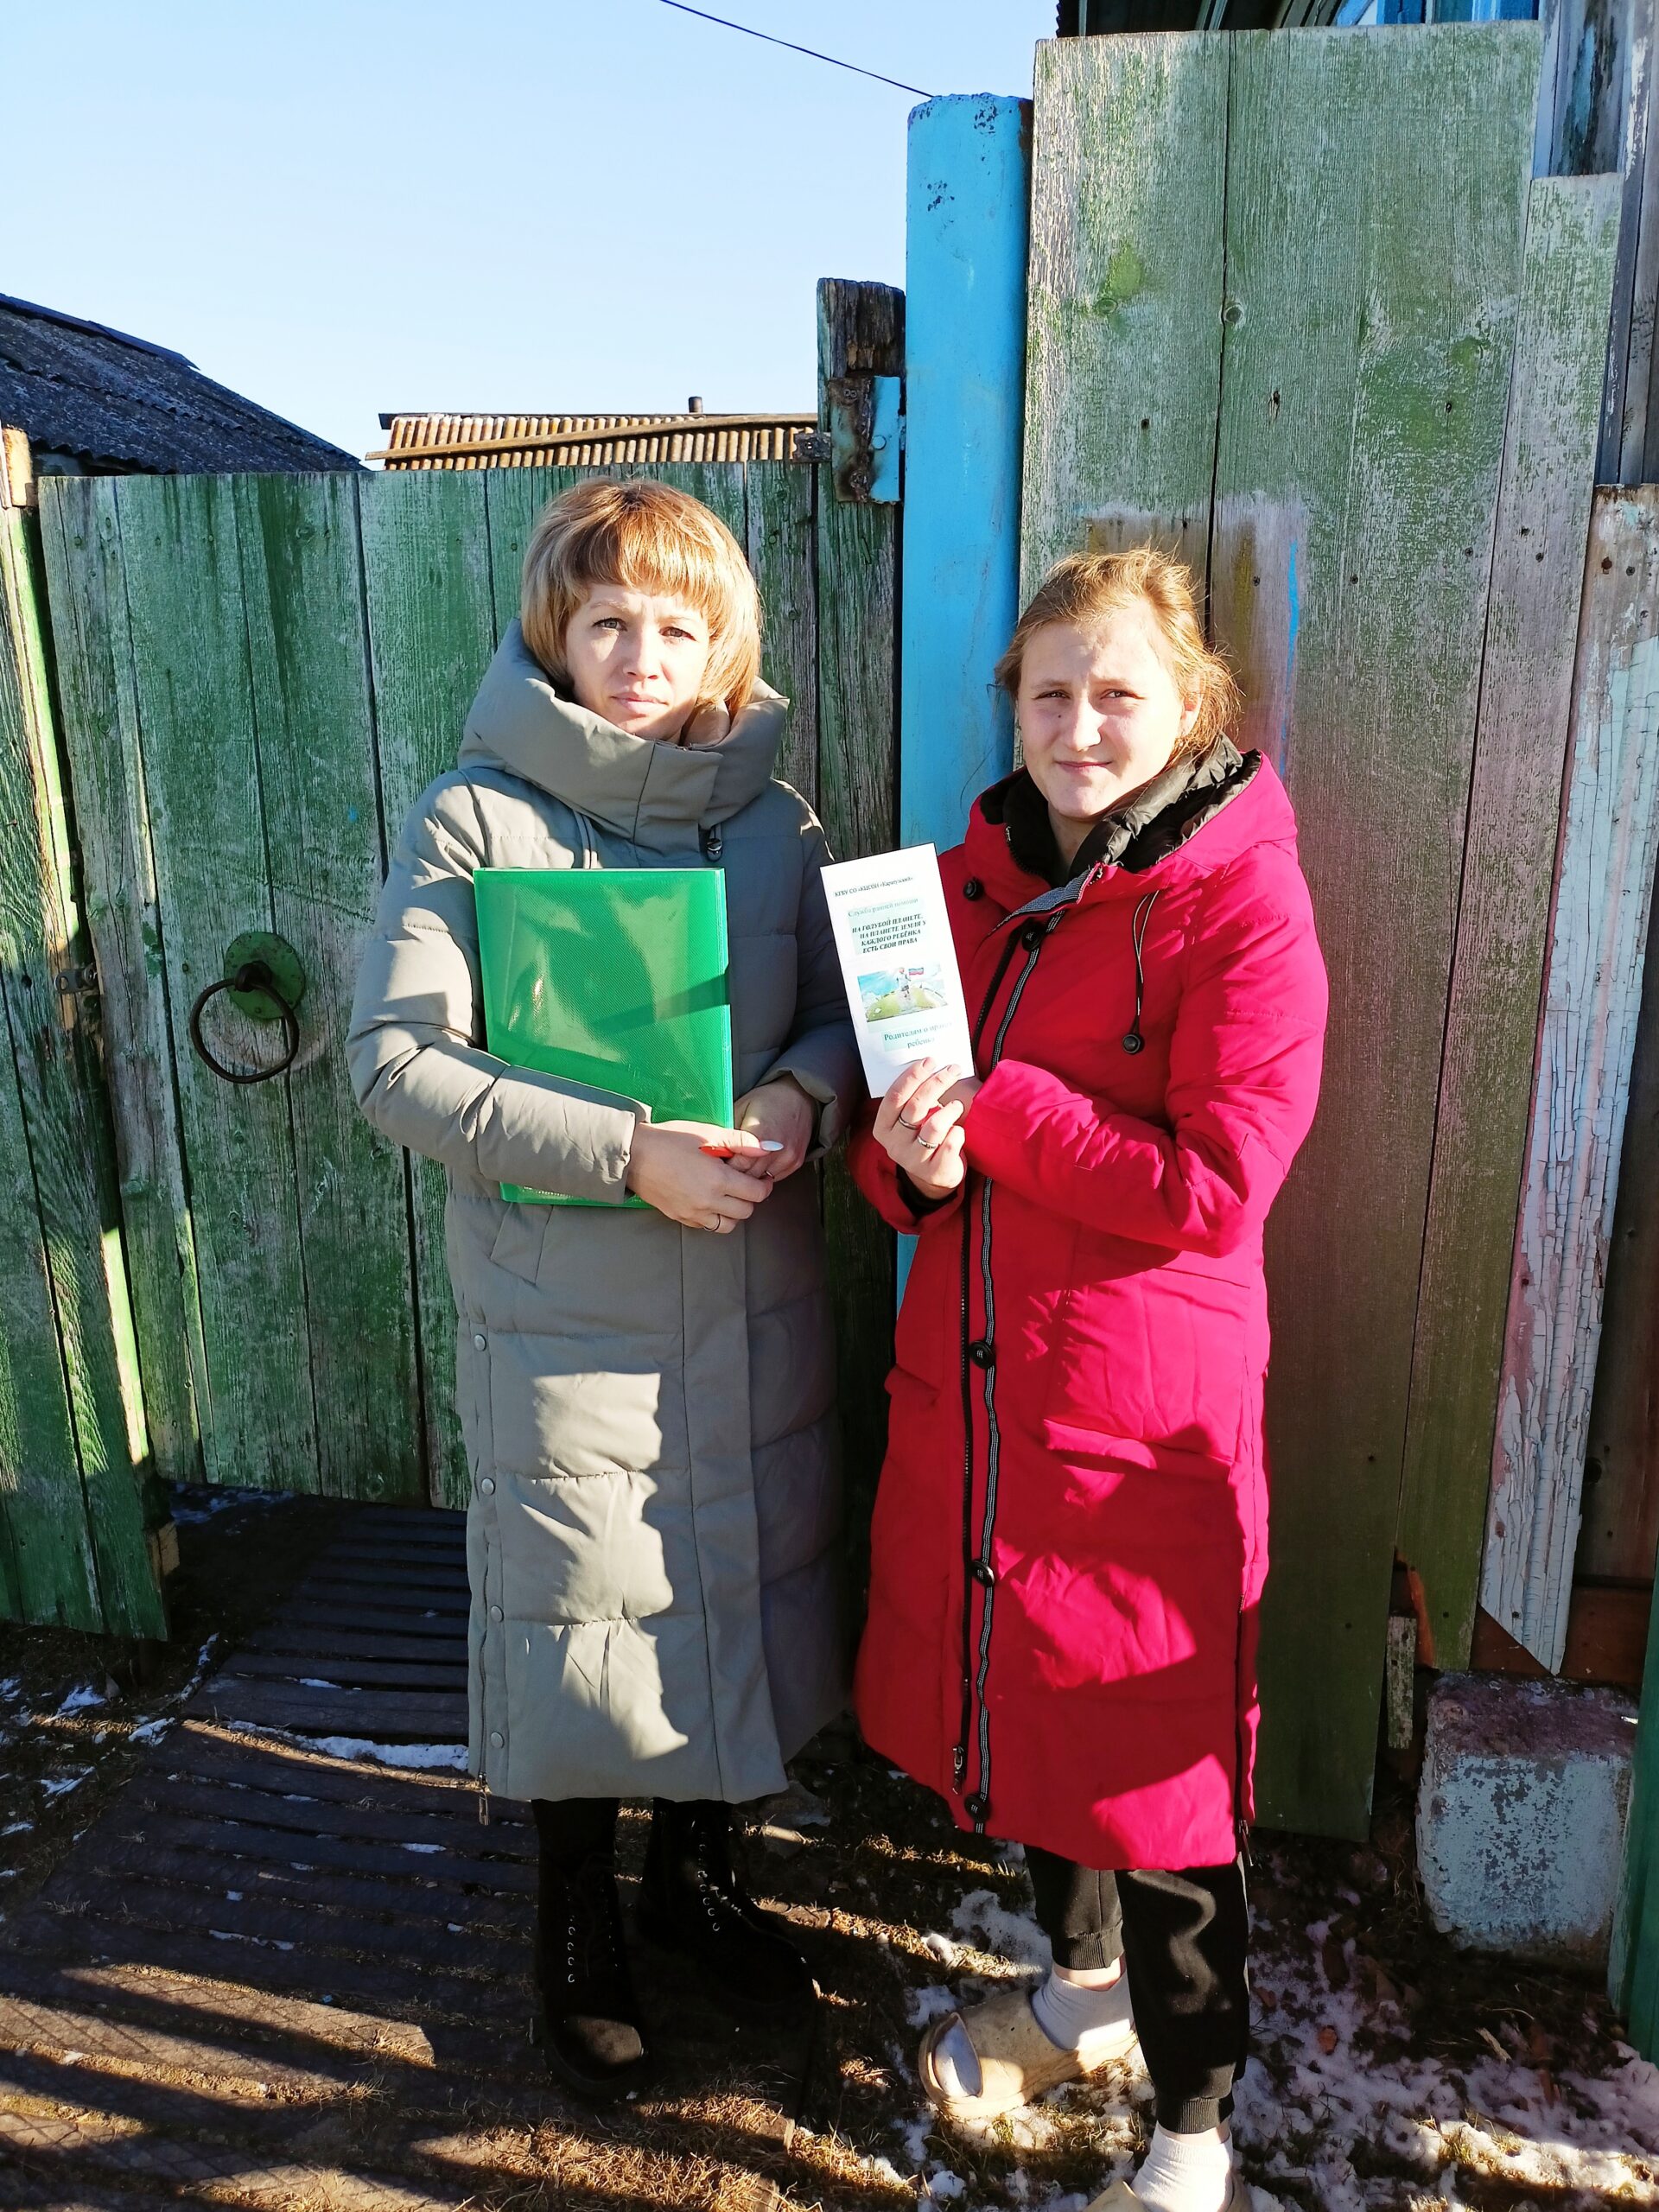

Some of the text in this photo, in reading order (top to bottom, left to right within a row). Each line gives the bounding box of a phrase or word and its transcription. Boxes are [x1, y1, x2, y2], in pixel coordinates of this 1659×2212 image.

[861, 917, 892, 931] ГОЛУБОЙ
[869, 925, 899, 938] ПЛАНЕТЕ
[900, 920, 921, 931] ЗЕМЛЯ
[862, 945, 879, 954] ЕСТЬ
[898, 937, 918, 946] ПРАВА
[884, 1028, 922, 1041] Родителям
